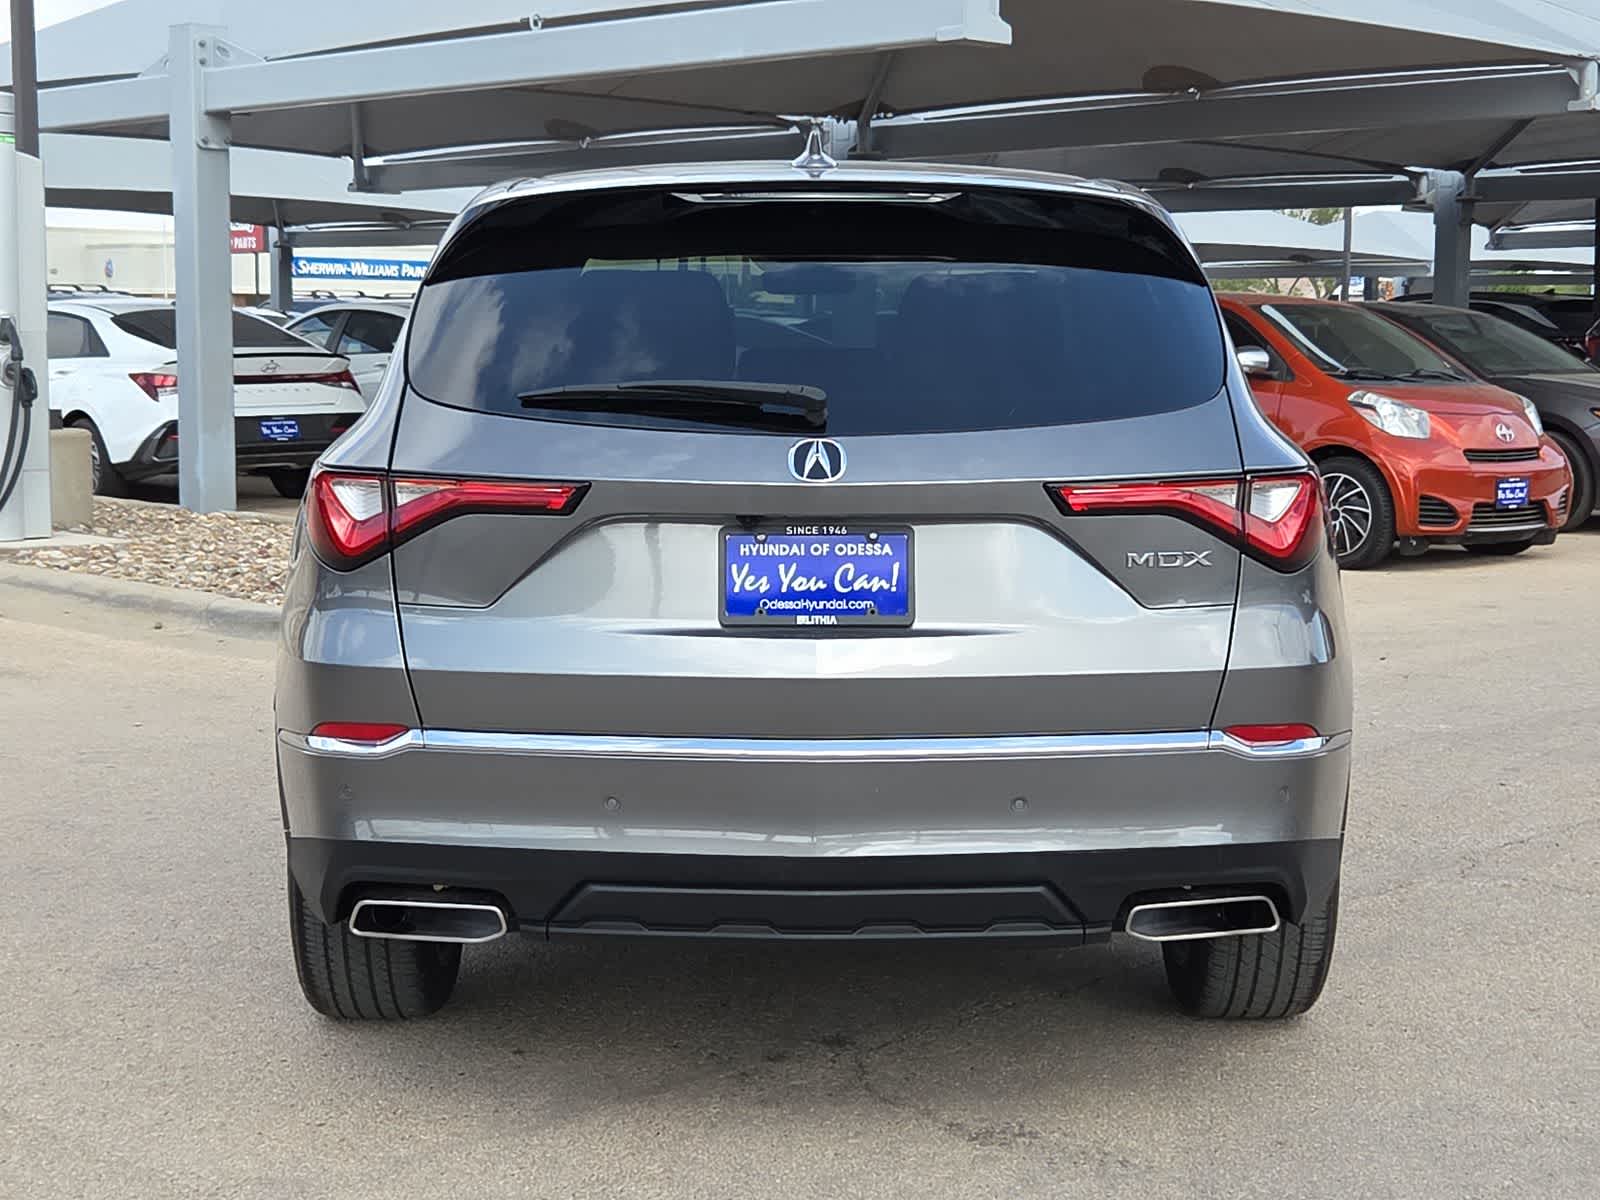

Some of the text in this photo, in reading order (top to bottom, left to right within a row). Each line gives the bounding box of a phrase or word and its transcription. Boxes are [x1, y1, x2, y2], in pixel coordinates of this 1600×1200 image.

[298, 260, 399, 277] SHERWIN-WILLIAMS
[785, 525, 848, 536] SINCE 1946
[740, 543, 893, 556] HYUNDAI OF ODESSA
[1126, 550, 1213, 569] MDX
[731, 561, 900, 593] Yes You Can!
[759, 598, 874, 611] OdessaHyundai.com
